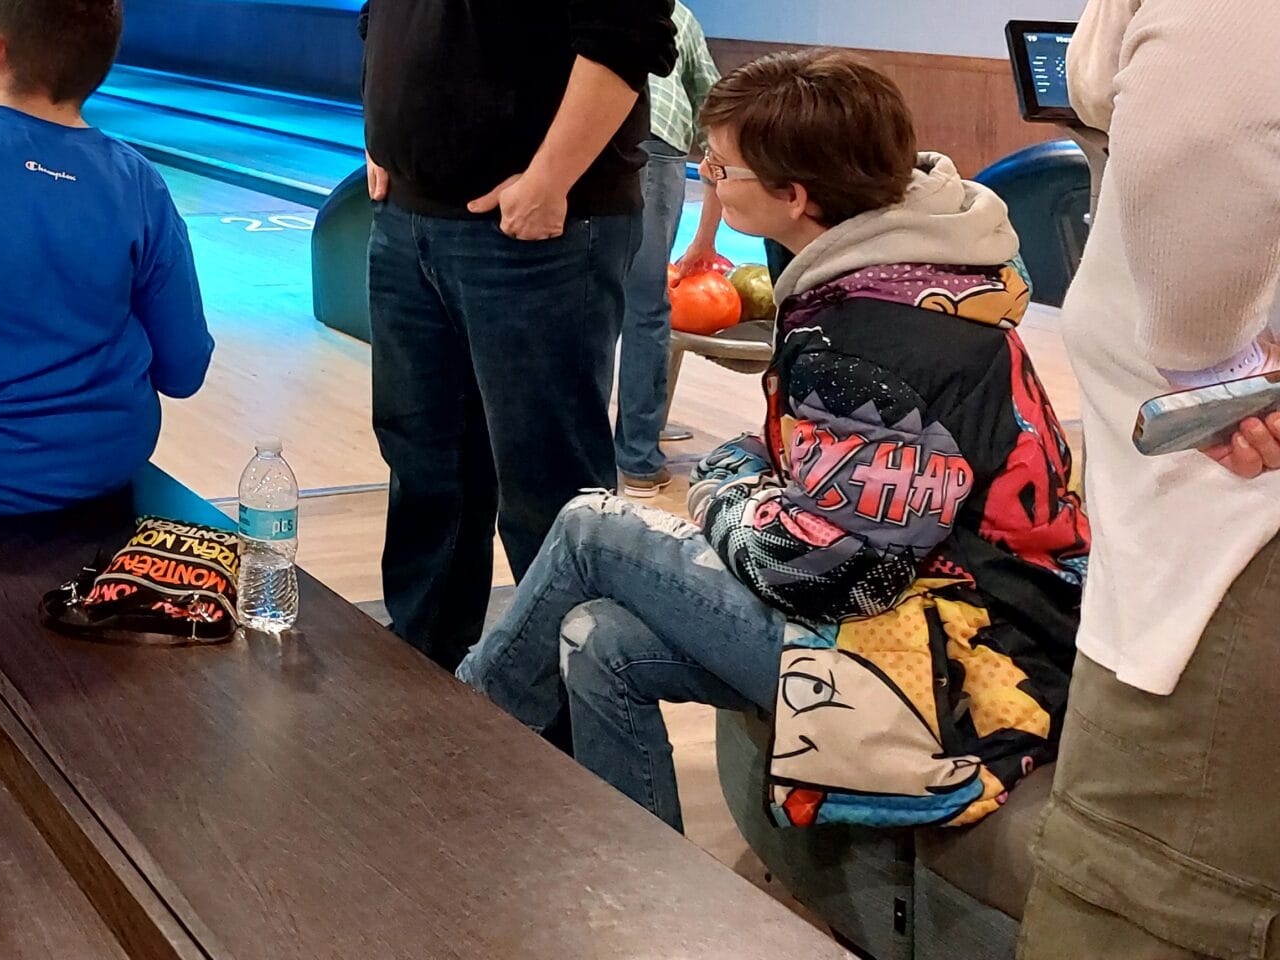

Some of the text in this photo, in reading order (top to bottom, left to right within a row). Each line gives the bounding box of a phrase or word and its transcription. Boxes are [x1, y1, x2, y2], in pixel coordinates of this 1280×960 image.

[25, 160, 76, 181] Champion
[221, 215, 316, 232] 20
[849, 441, 975, 528] HAP
